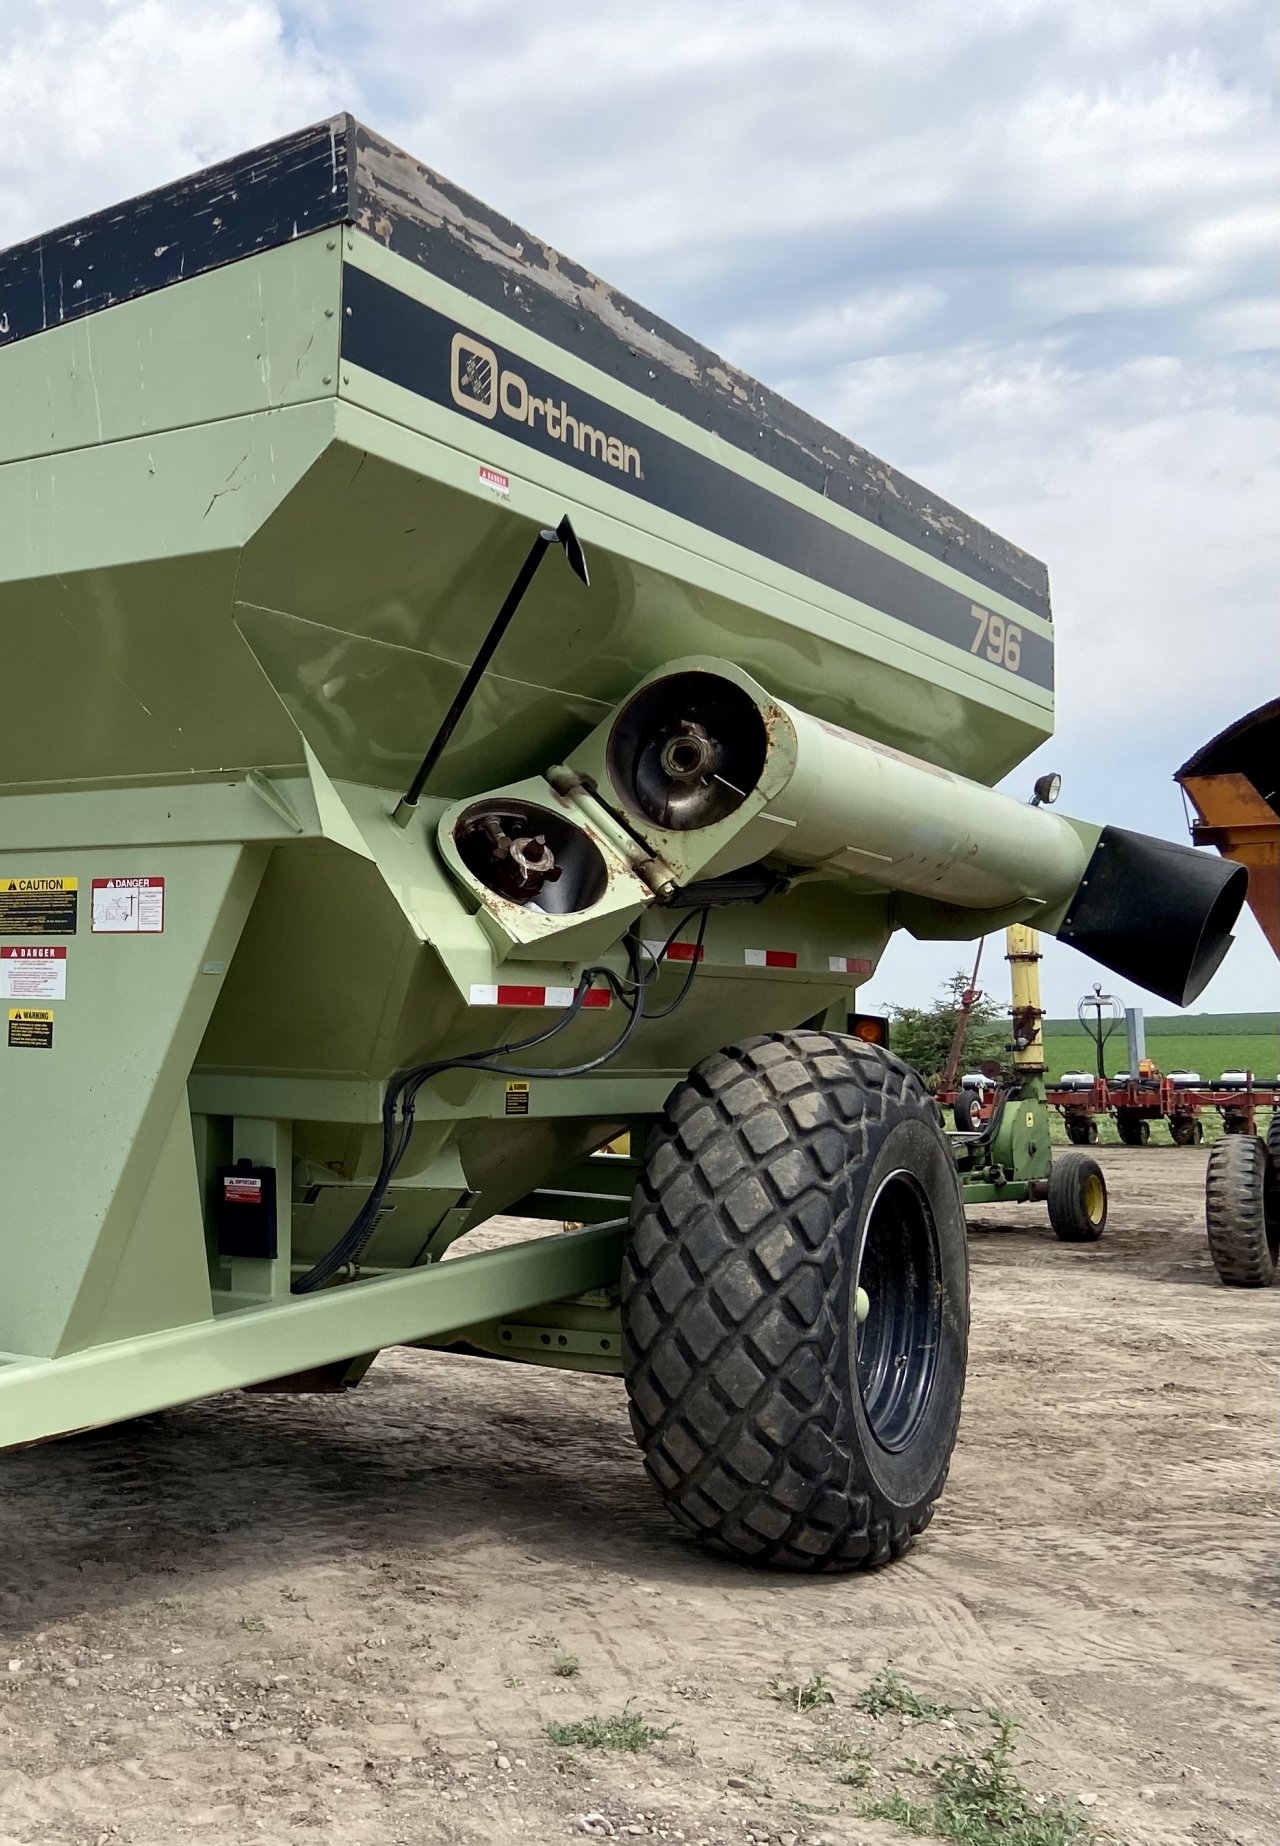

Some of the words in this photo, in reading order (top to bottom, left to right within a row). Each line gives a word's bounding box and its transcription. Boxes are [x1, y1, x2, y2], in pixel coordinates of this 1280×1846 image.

[500, 370, 641, 479] Orthman
[970, 605, 1022, 672] 796
[19, 879, 64, 891] CAUTION
[115, 879, 150, 888] DANGER
[20, 948, 55, 957] DANGER
[23, 1011, 49, 1020] WARNING
